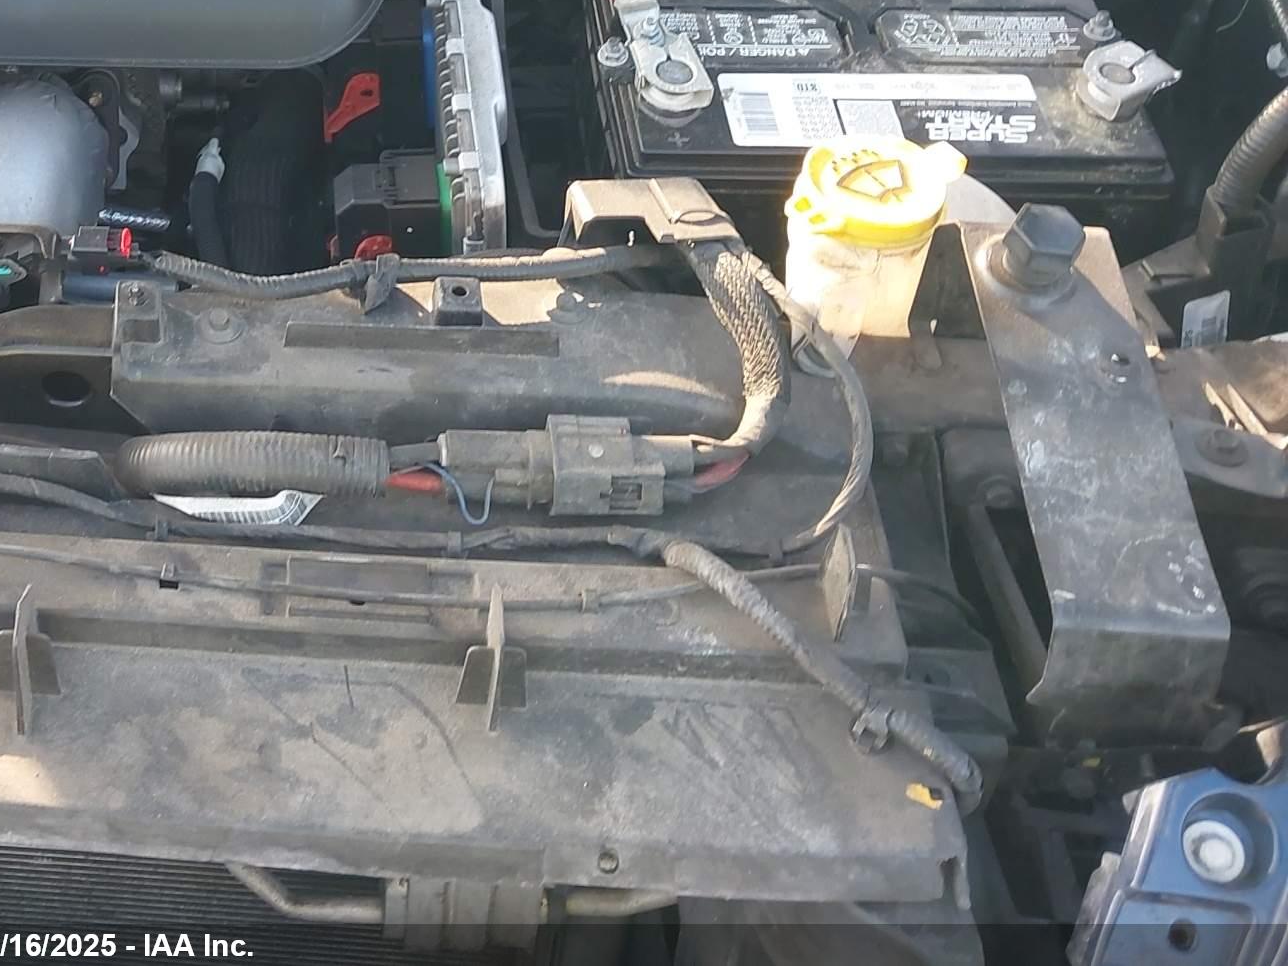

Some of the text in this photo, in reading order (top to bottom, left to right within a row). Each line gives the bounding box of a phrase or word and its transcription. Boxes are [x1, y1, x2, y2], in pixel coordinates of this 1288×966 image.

[740, 47, 796, 57] DANGER
[924, 115, 1037, 132] START
[927, 127, 1029, 144] SUPER
